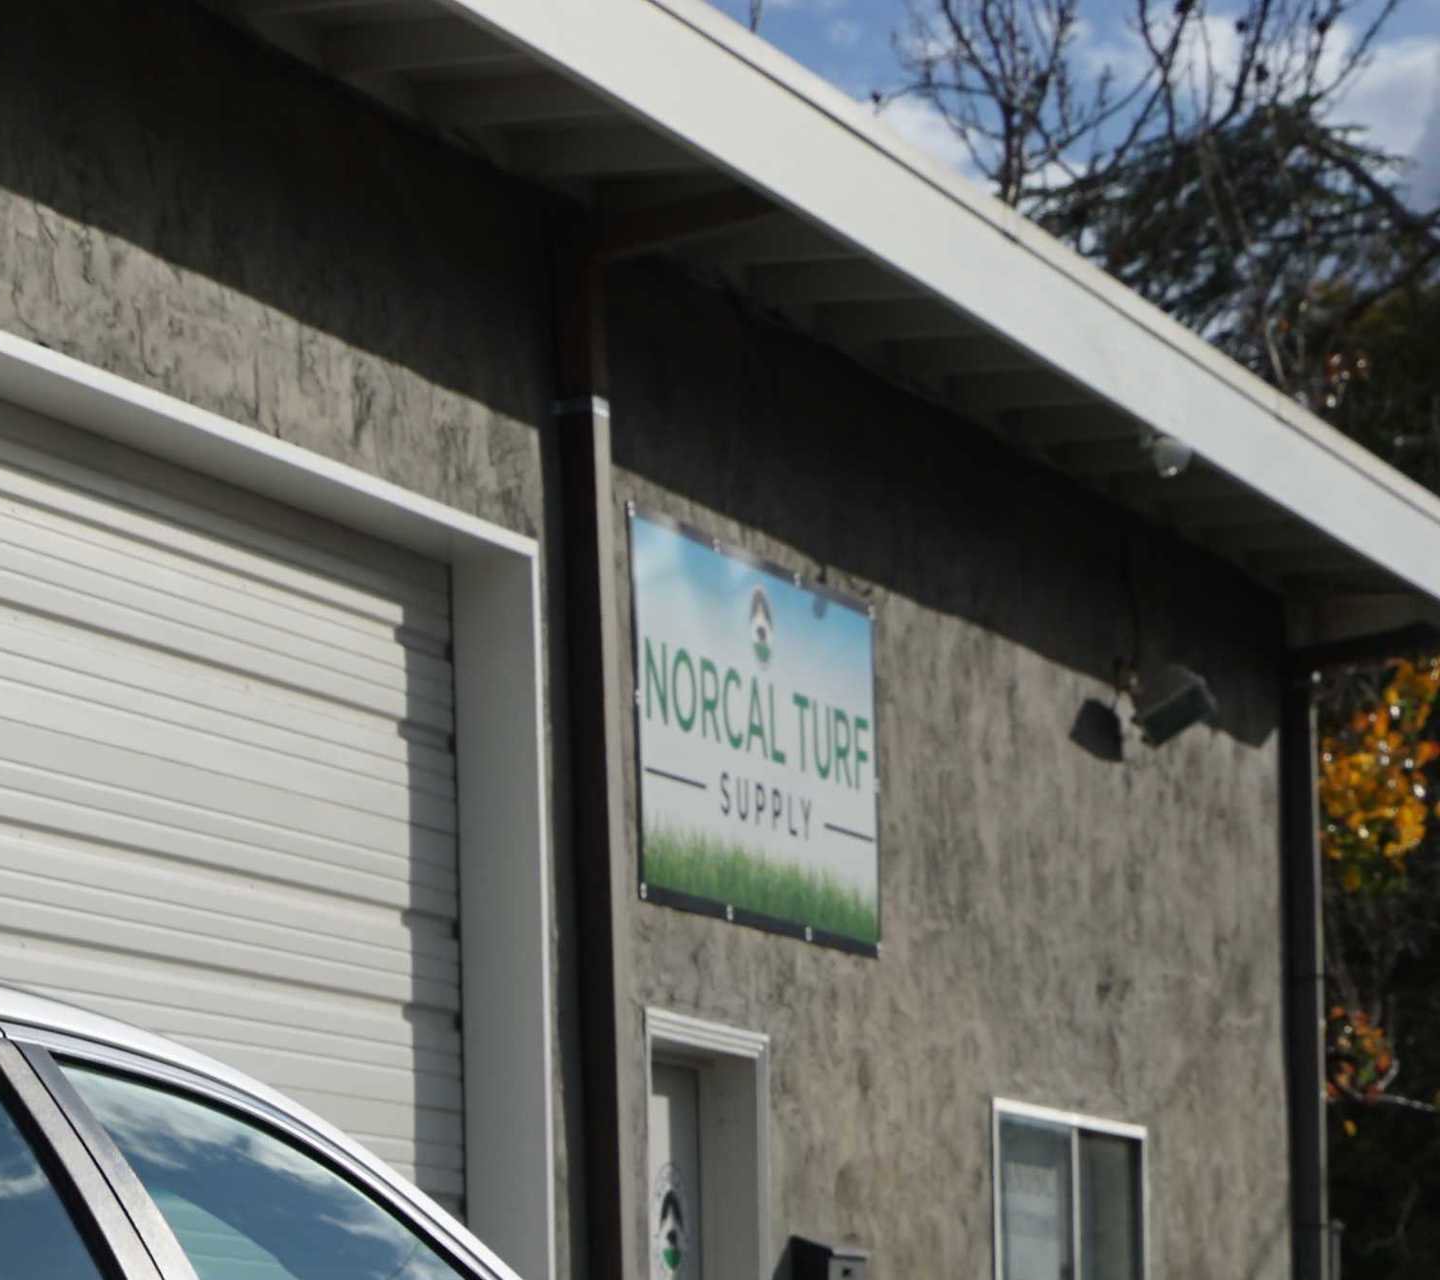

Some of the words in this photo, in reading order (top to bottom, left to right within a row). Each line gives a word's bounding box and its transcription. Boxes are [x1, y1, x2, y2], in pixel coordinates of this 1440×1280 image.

[643, 637, 786, 764] NORCAL
[792, 692, 870, 790] TURF
[719, 771, 813, 841] SUPPLY
